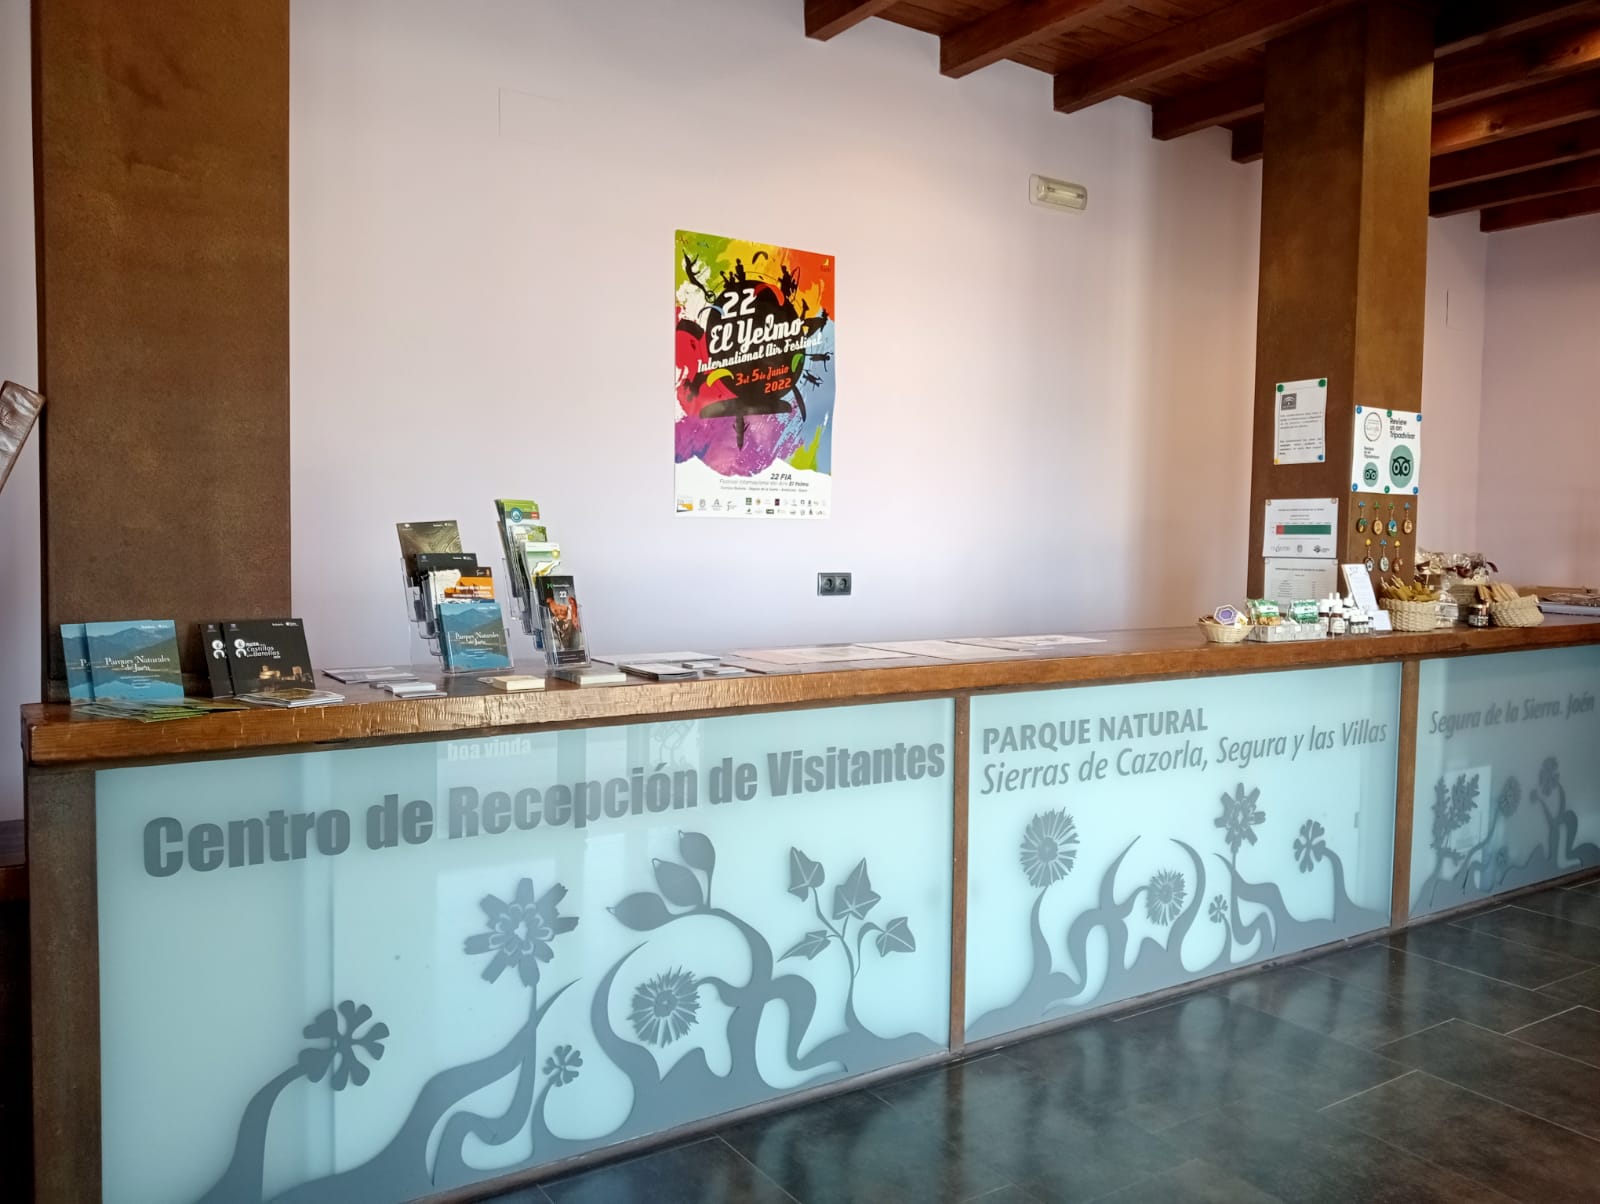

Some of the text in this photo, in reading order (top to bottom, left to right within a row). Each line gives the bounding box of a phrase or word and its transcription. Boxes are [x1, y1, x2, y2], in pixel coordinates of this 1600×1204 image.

[721, 288, 757, 320] 22
[697, 331, 824, 374] International Air Festival
[709, 314, 805, 354] El Yelmo
[764, 378, 792, 394] 2022
[766, 364, 789, 381] Junio
[104, 655, 171, 668] Parques Naturales
[982, 708, 1209, 755] PARQUE NATURAL
[1429, 711, 1482, 740] Segura
[1484, 702, 1504, 727] de
[1505, 700, 1519, 723] la
[1565, 690, 1595, 720] Jaén
[980, 719, 1388, 795] Sierras de Cazorla, Segura y las Villas
[143, 742, 946, 879] Centro de Recepción de Visitantes
